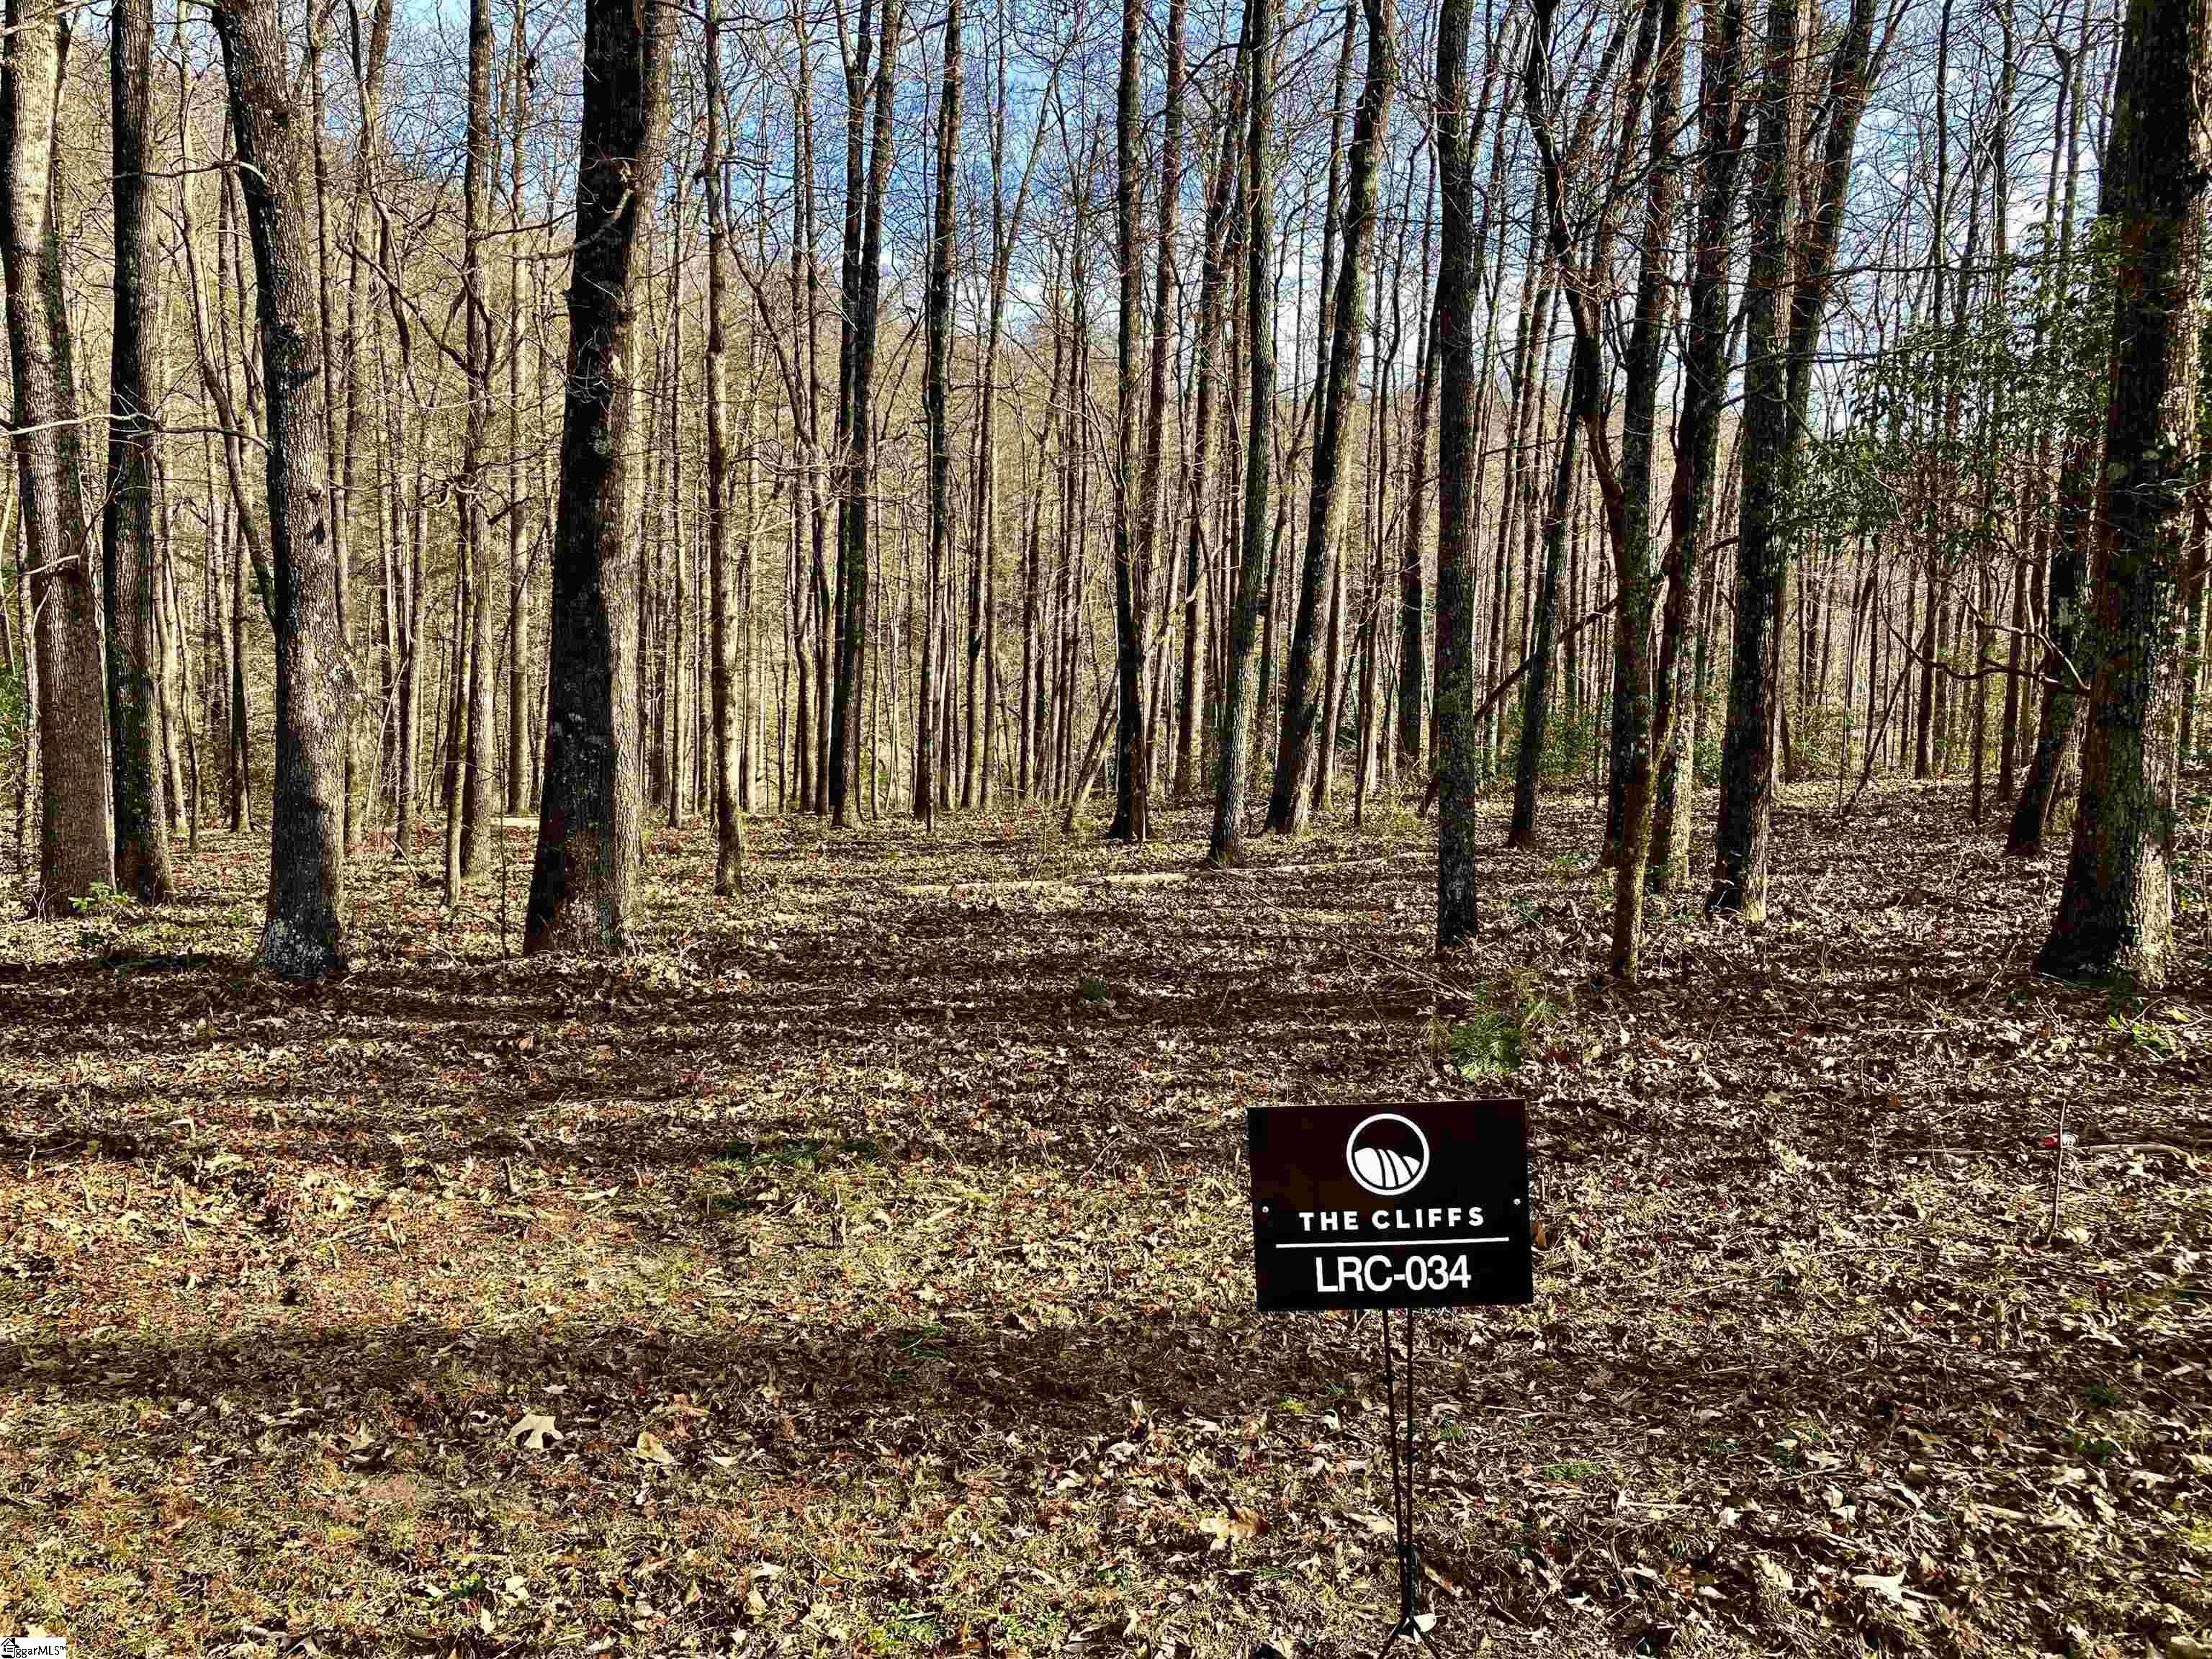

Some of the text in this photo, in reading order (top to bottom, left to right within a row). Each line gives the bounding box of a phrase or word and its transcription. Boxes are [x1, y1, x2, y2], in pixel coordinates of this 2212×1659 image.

[1298, 1206, 1485, 1231] THE CLIFFS
[1316, 1254, 1472, 1293] LRC-034
